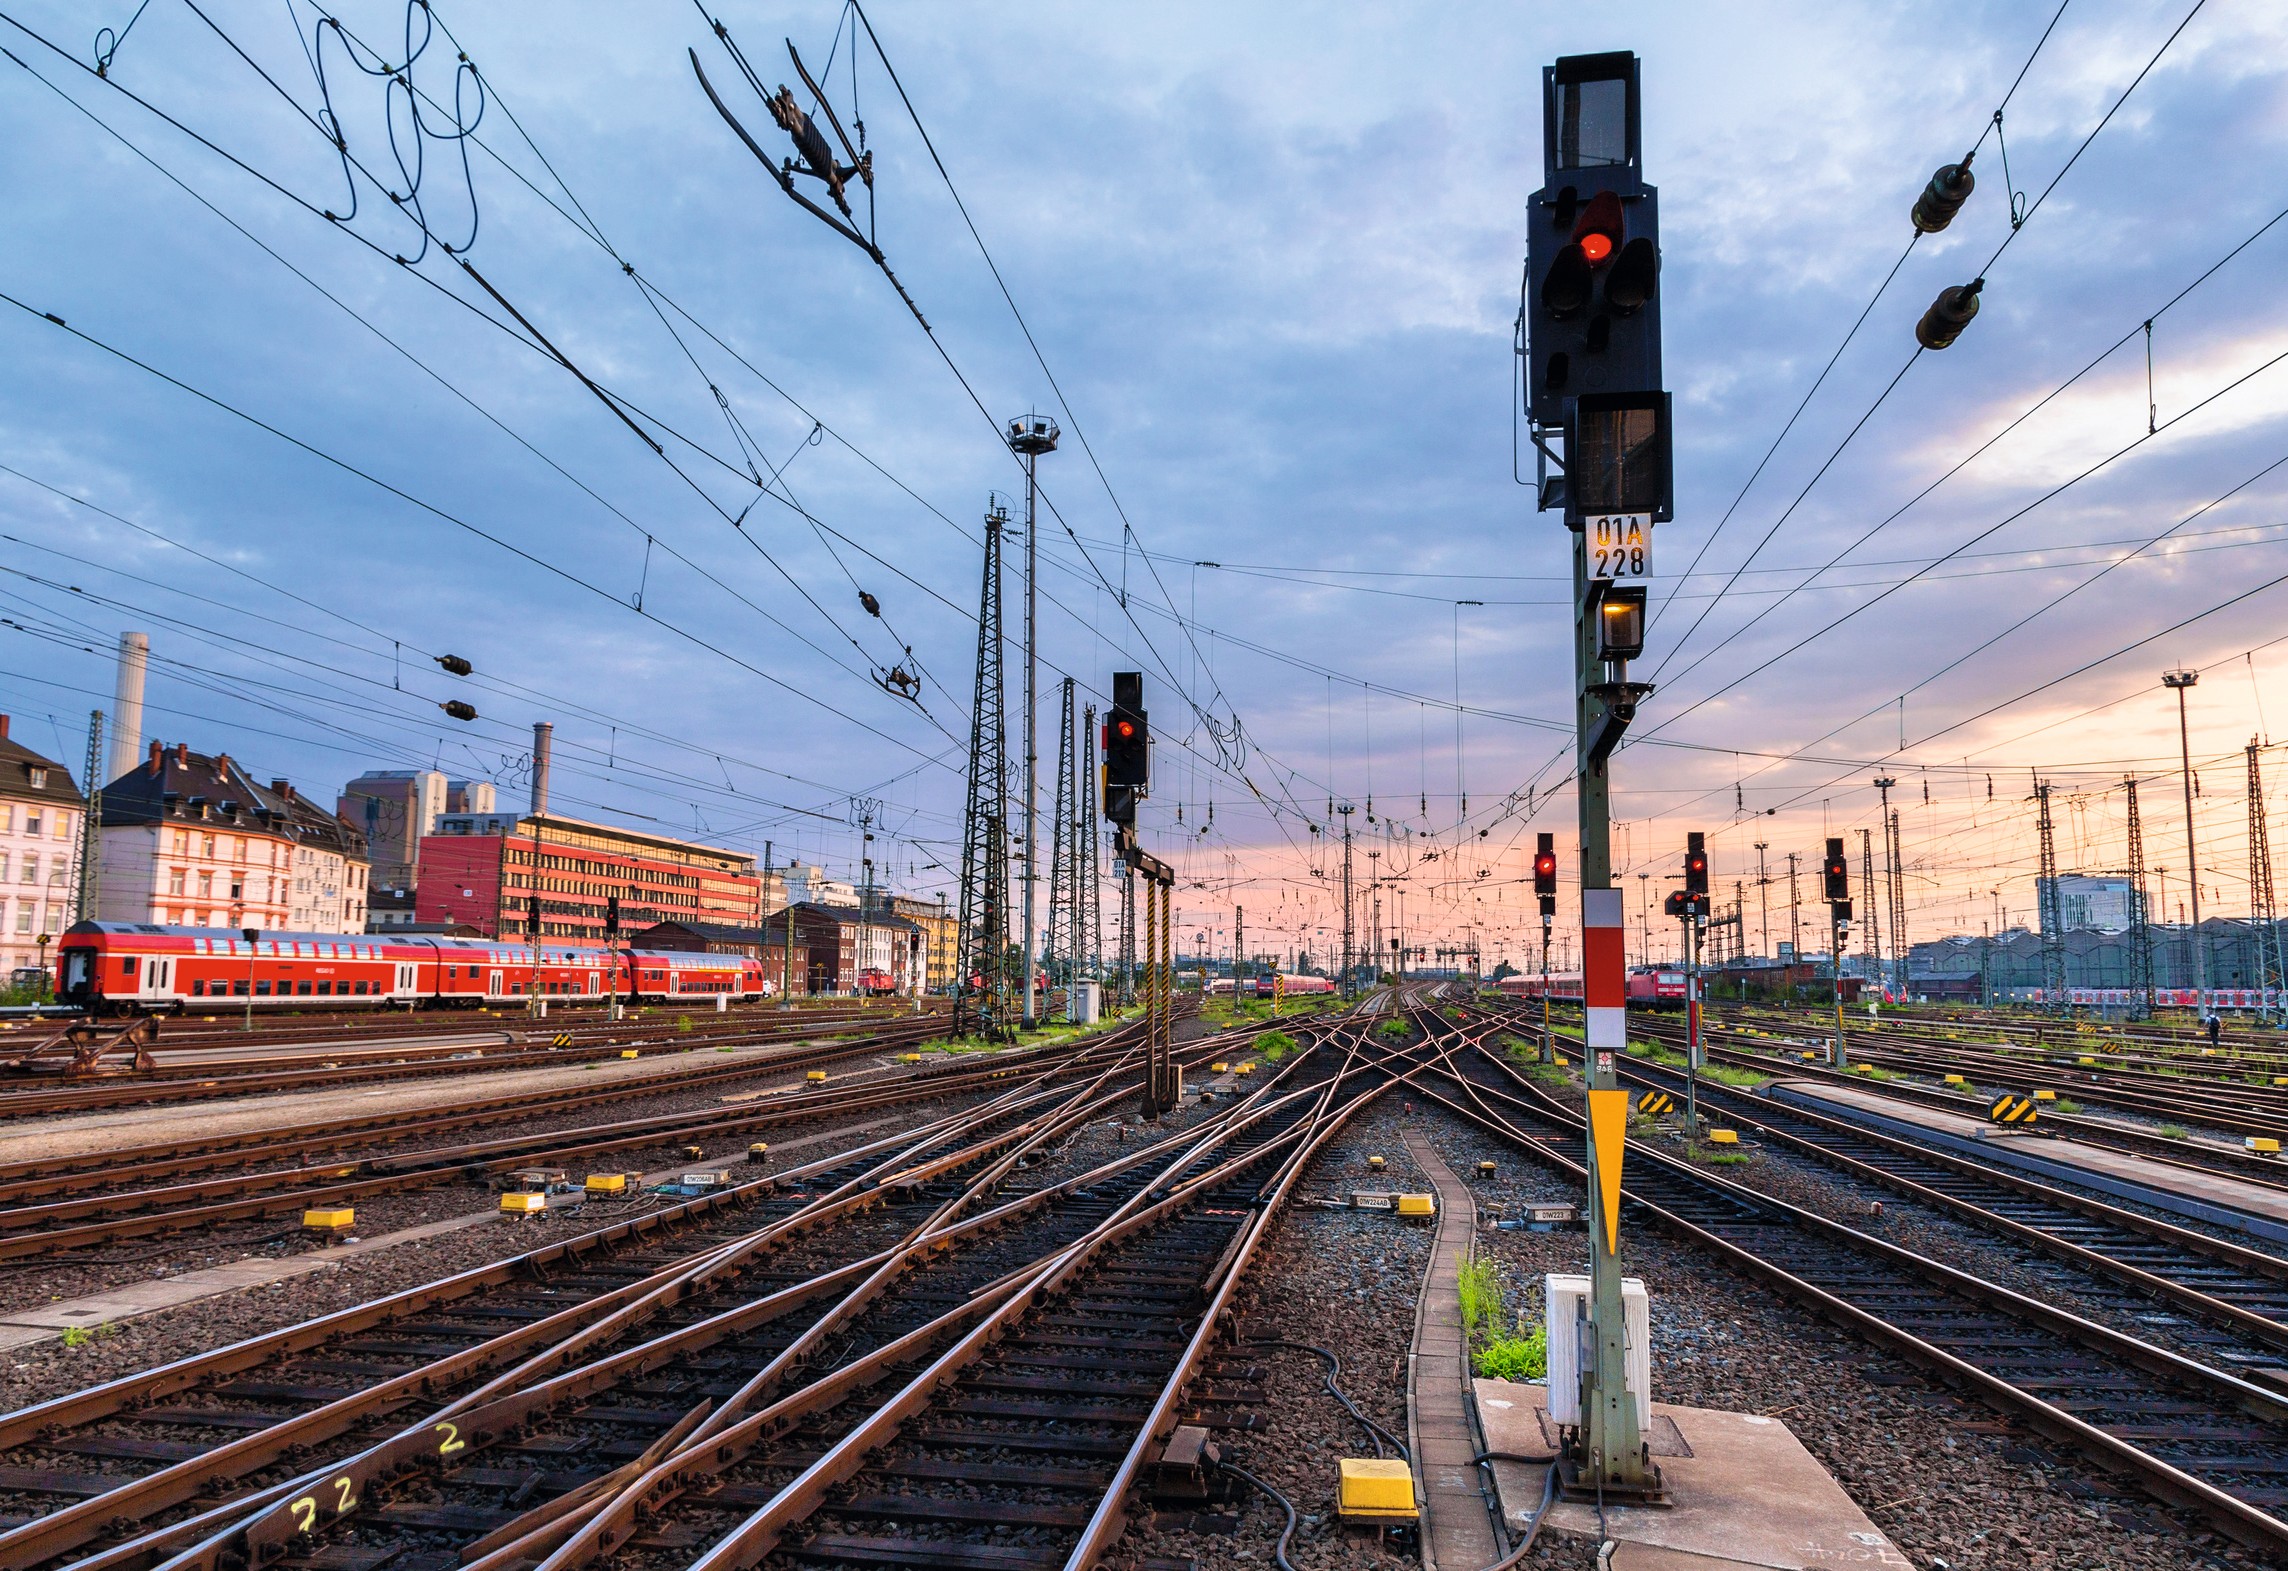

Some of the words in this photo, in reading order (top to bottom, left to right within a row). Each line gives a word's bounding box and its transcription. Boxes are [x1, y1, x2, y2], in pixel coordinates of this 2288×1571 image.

[1596, 516, 1643, 547] 01A
[1595, 547, 1644, 578] 228
[1114, 860, 1125, 869] 01A
[1114, 870, 1124, 878] 217
[1542, 1211, 1564, 1219] 01W223
[435, 1422, 465, 1455] 2
[334, 1476, 358, 1513] 2
